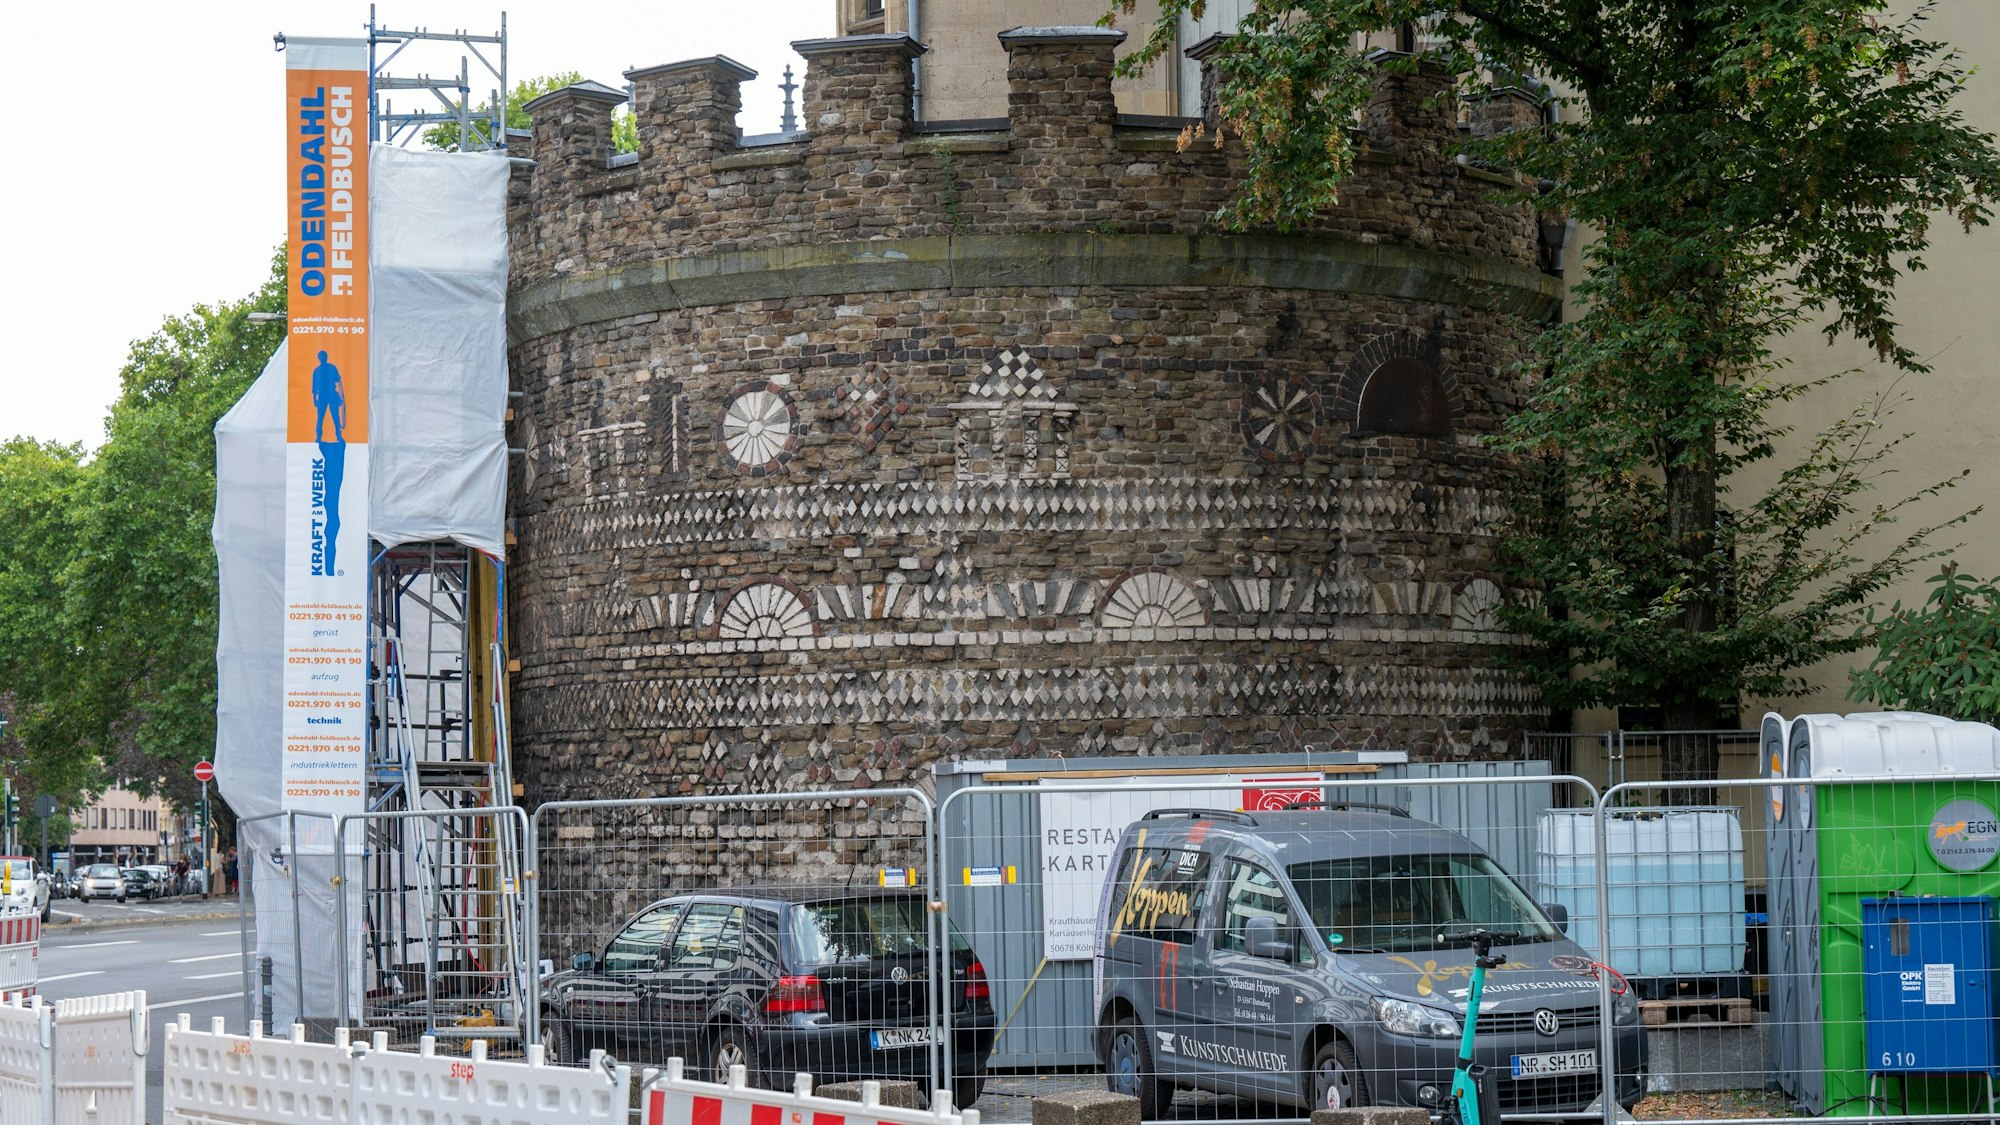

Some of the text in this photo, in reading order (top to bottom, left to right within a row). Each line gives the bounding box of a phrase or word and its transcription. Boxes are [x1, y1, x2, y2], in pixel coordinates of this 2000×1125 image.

[331, 87, 353, 269] FELDBUSCH
[300, 87, 326, 297] ODENDAHL
[293, 326, 365, 334] 0221.970 41 90
[312, 458, 324, 508] WERK
[311, 519, 323, 576] KRAFT
[312, 628, 339, 638] gerüst
[311, 673, 339, 681] aufzug
[290, 761, 358, 769] industrieklettern
[1967, 821, 1997, 833] EGN
[1048, 855, 1108, 872] KART
[1179, 852, 1199, 867] DICH
[1900, 972, 1922, 980] OPK
[1228, 976, 1279, 998] Sebastian Hoppen
[882, 1028, 932, 1044] K NK 24
[1180, 1034, 1289, 1072] KUNSTSCHMIEDE
[1521, 1053, 1594, 1073] NR SH 101
[451, 1061, 473, 1085] step
